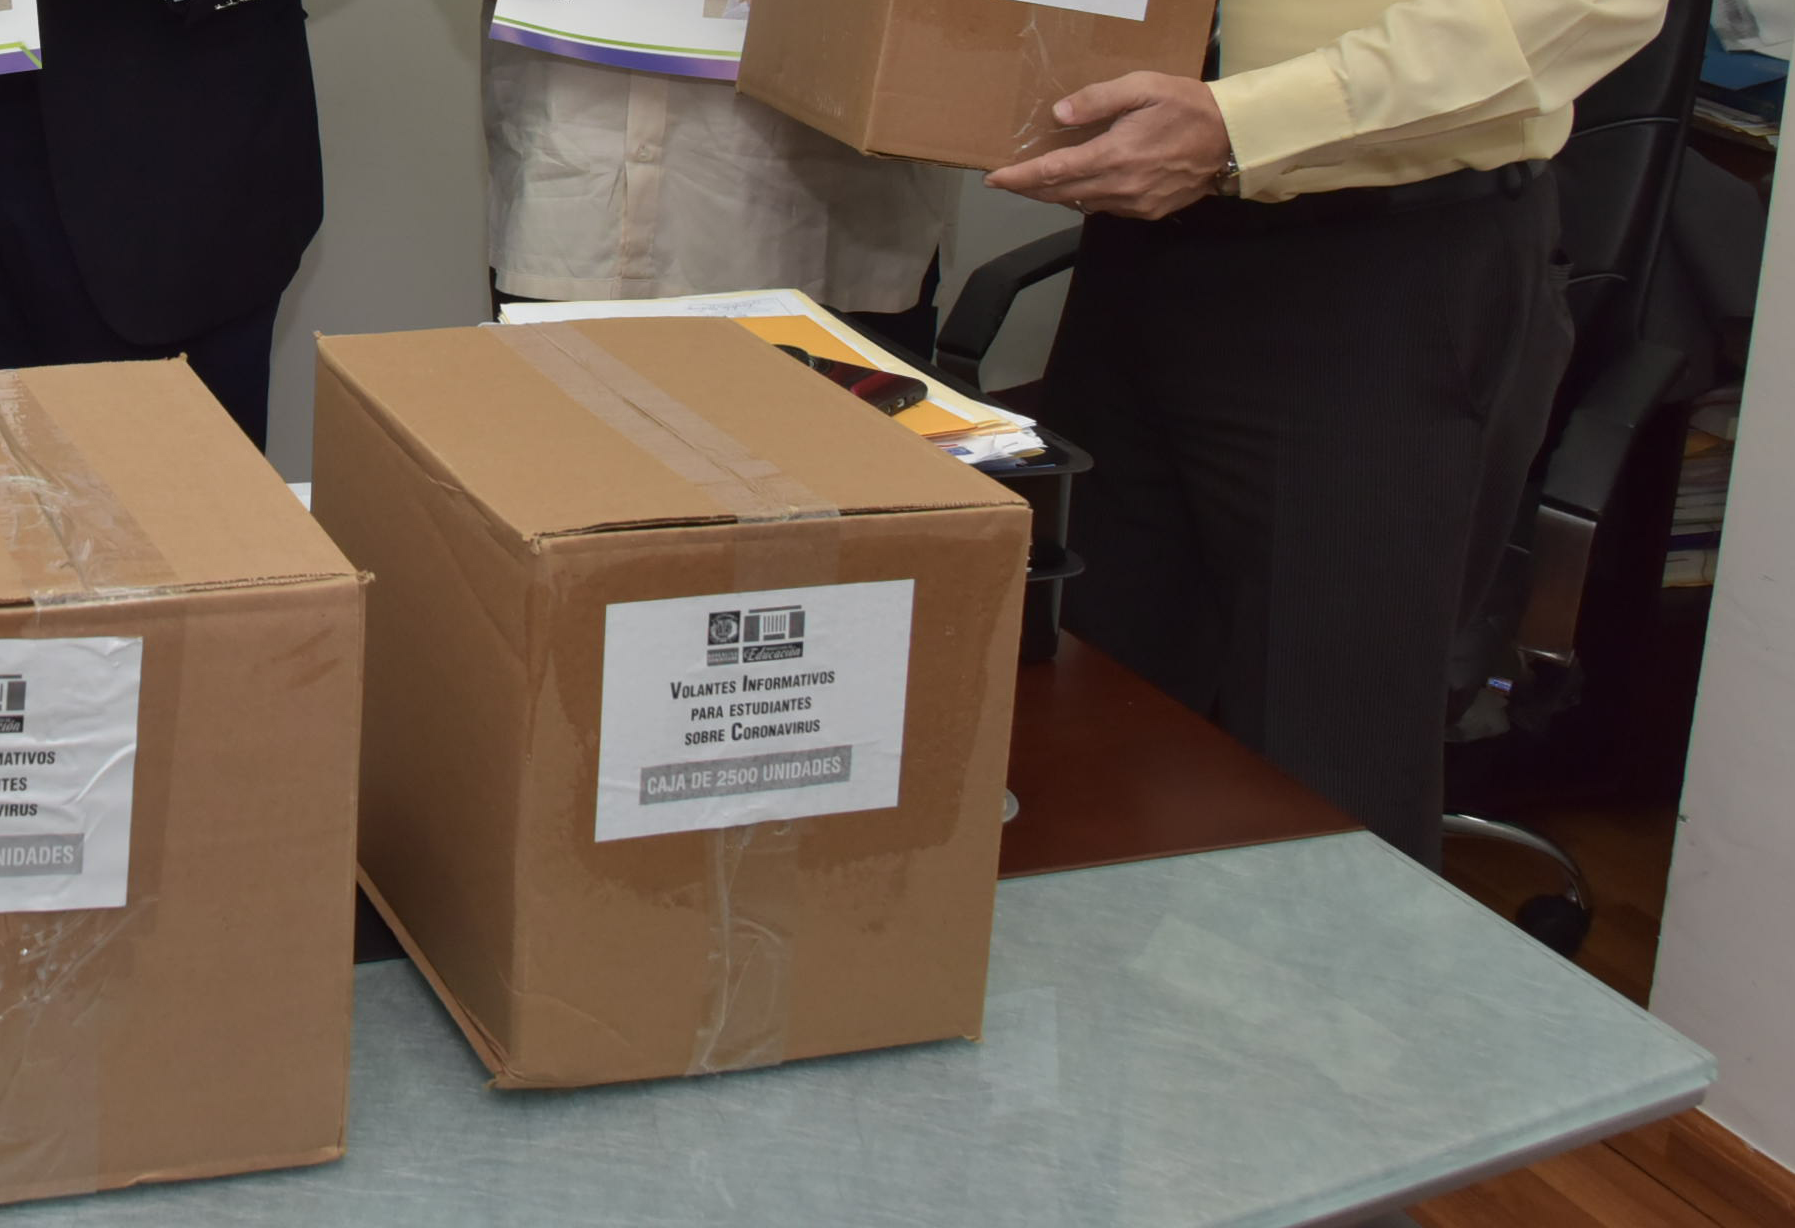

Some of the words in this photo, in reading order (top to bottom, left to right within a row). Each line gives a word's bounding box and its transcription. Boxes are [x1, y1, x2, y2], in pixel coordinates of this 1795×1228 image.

[670, 680, 736, 700] VOLANTES
[742, 670, 835, 692] INFORMATIVOS
[691, 707, 724, 721] PARA
[729, 696, 812, 718] ESTUDIANTES
[684, 729, 725, 746] SOBRE
[731, 719, 821, 740] CORONAVIRUS
[647, 774, 686, 795] CAJA
[691, 771, 711, 788] DE
[717, 768, 759, 786] 2500
[763, 755, 842, 781] UNIDADES
